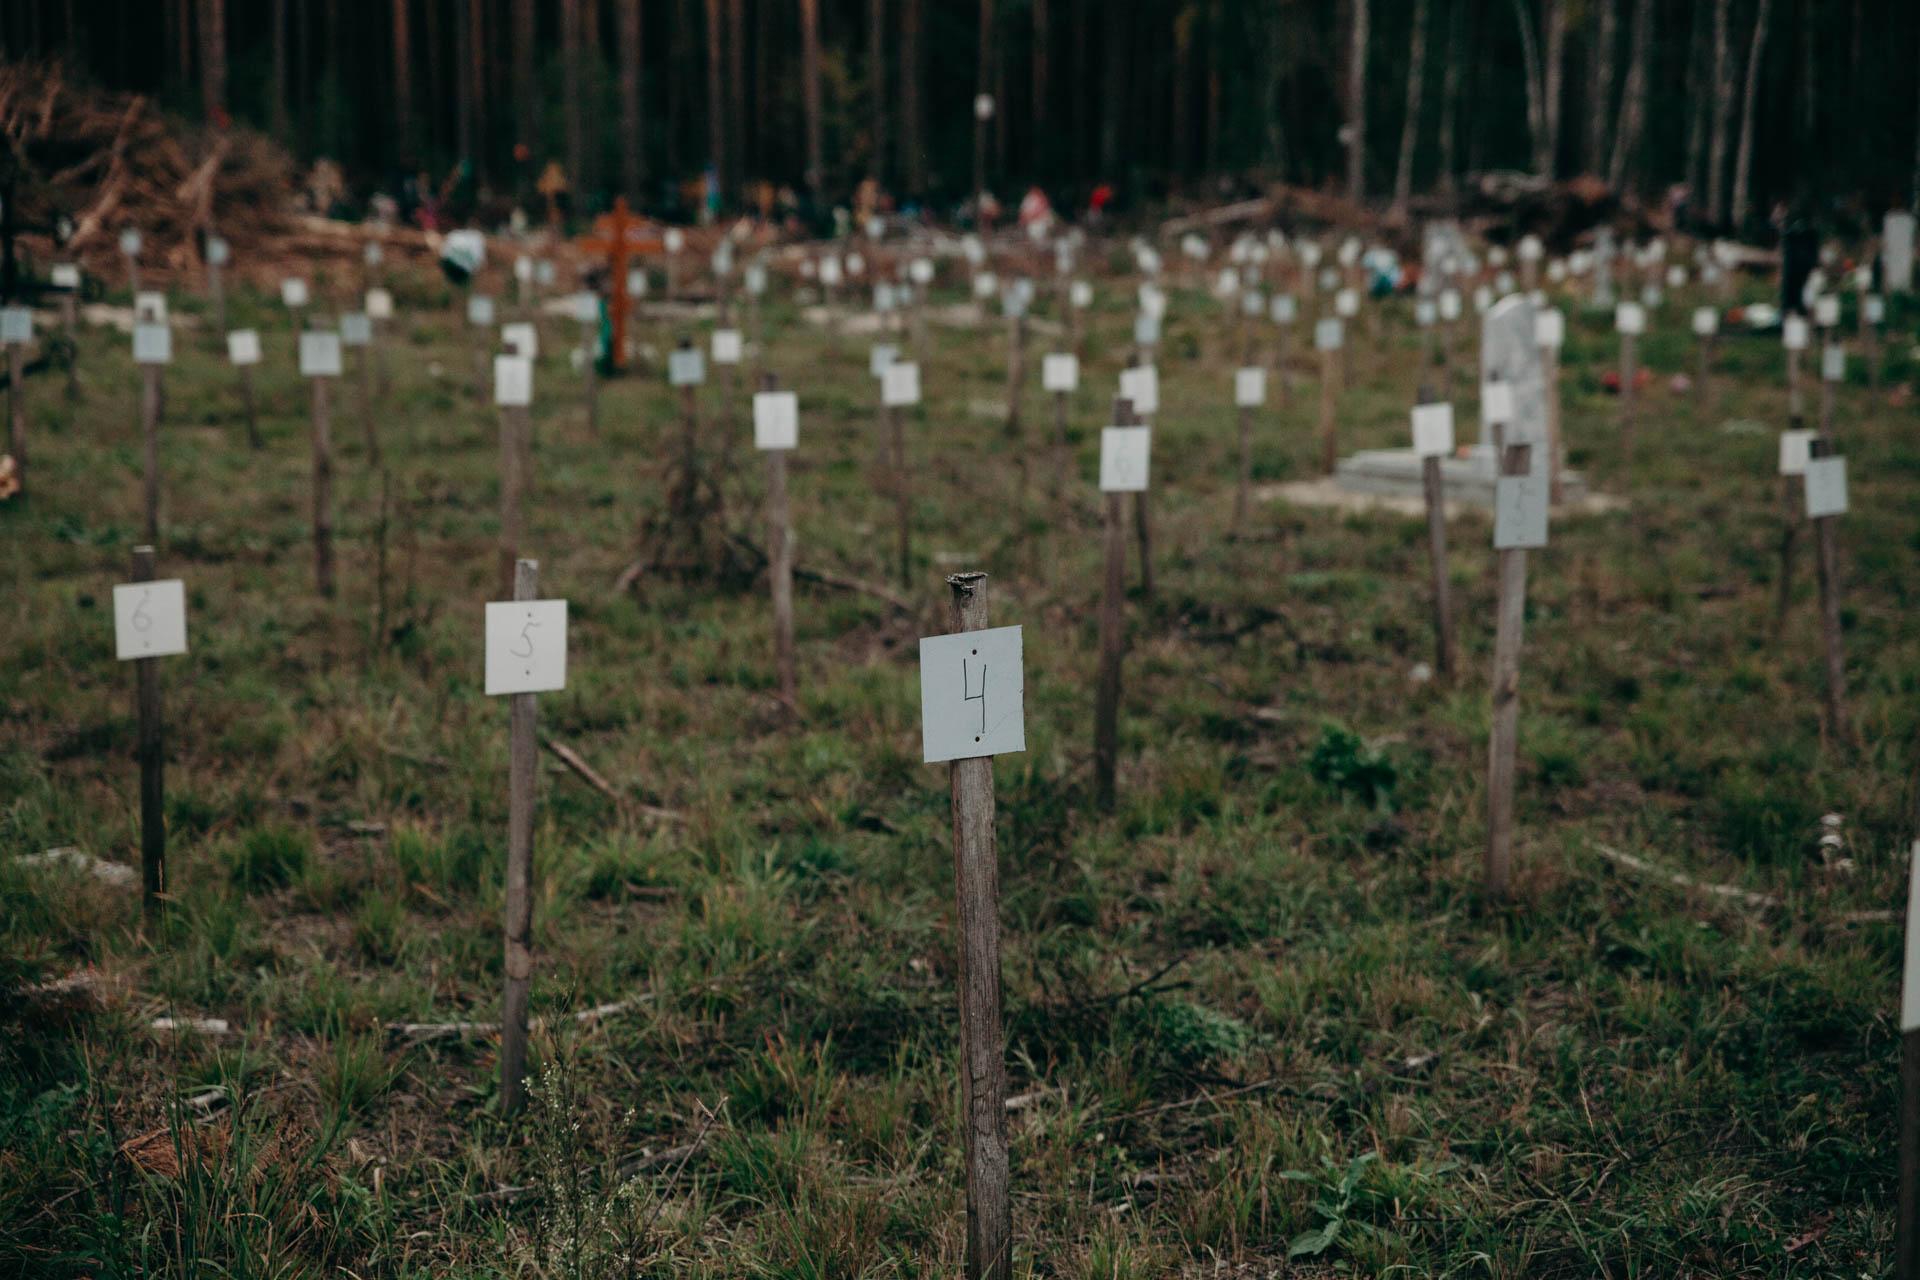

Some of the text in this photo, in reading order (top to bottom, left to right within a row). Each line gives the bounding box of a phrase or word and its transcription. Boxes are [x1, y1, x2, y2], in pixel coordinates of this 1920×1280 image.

[131, 596, 153, 633] 6
[509, 622, 542, 658] 5
[963, 658, 987, 734] 4
